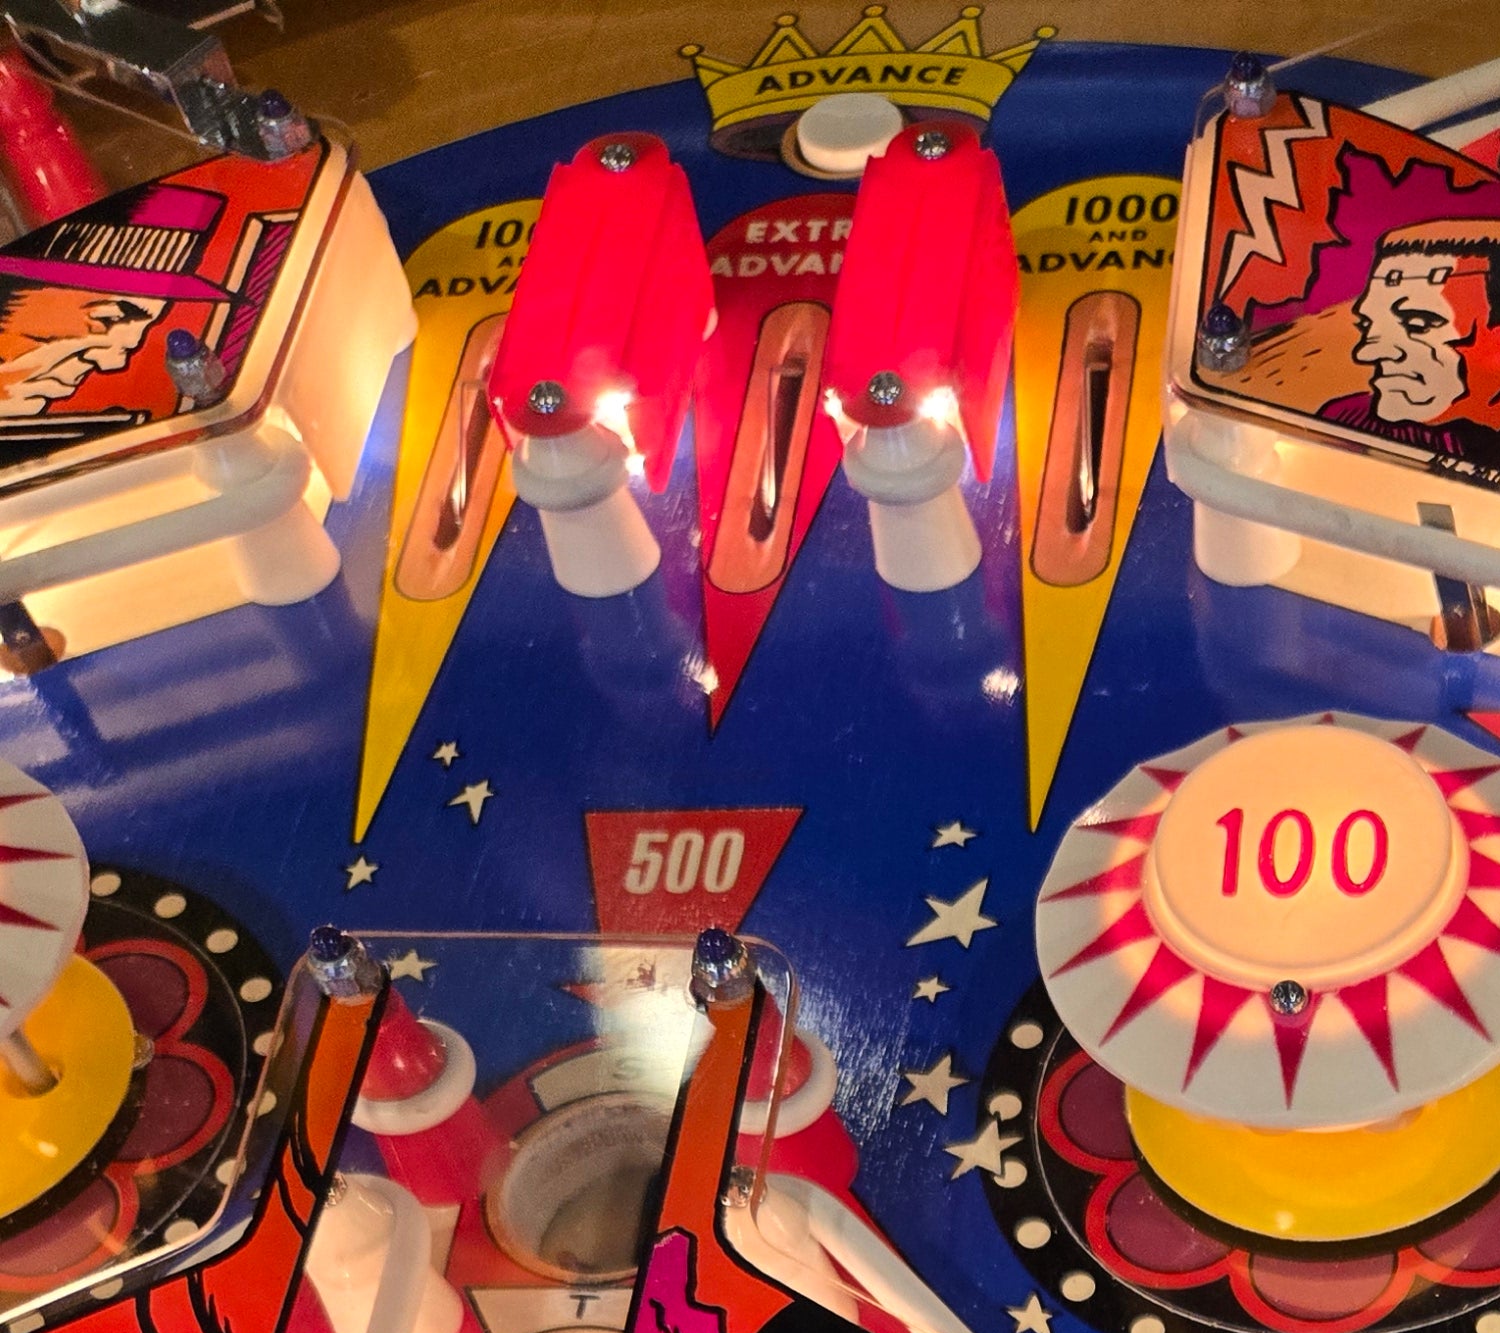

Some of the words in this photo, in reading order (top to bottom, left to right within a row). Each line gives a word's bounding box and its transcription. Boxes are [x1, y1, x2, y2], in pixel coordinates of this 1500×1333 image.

[755, 64, 967, 96] ADVANCE
[1065, 193, 1180, 226] 1000
[745, 217, 854, 244] EXTR
[1088, 229, 1149, 243] AND
[1017, 249, 1176, 274] ADVAN
[623, 829, 746, 895] 500
[1215, 807, 1389, 899] 100
[569, 1293, 602, 1320] T
